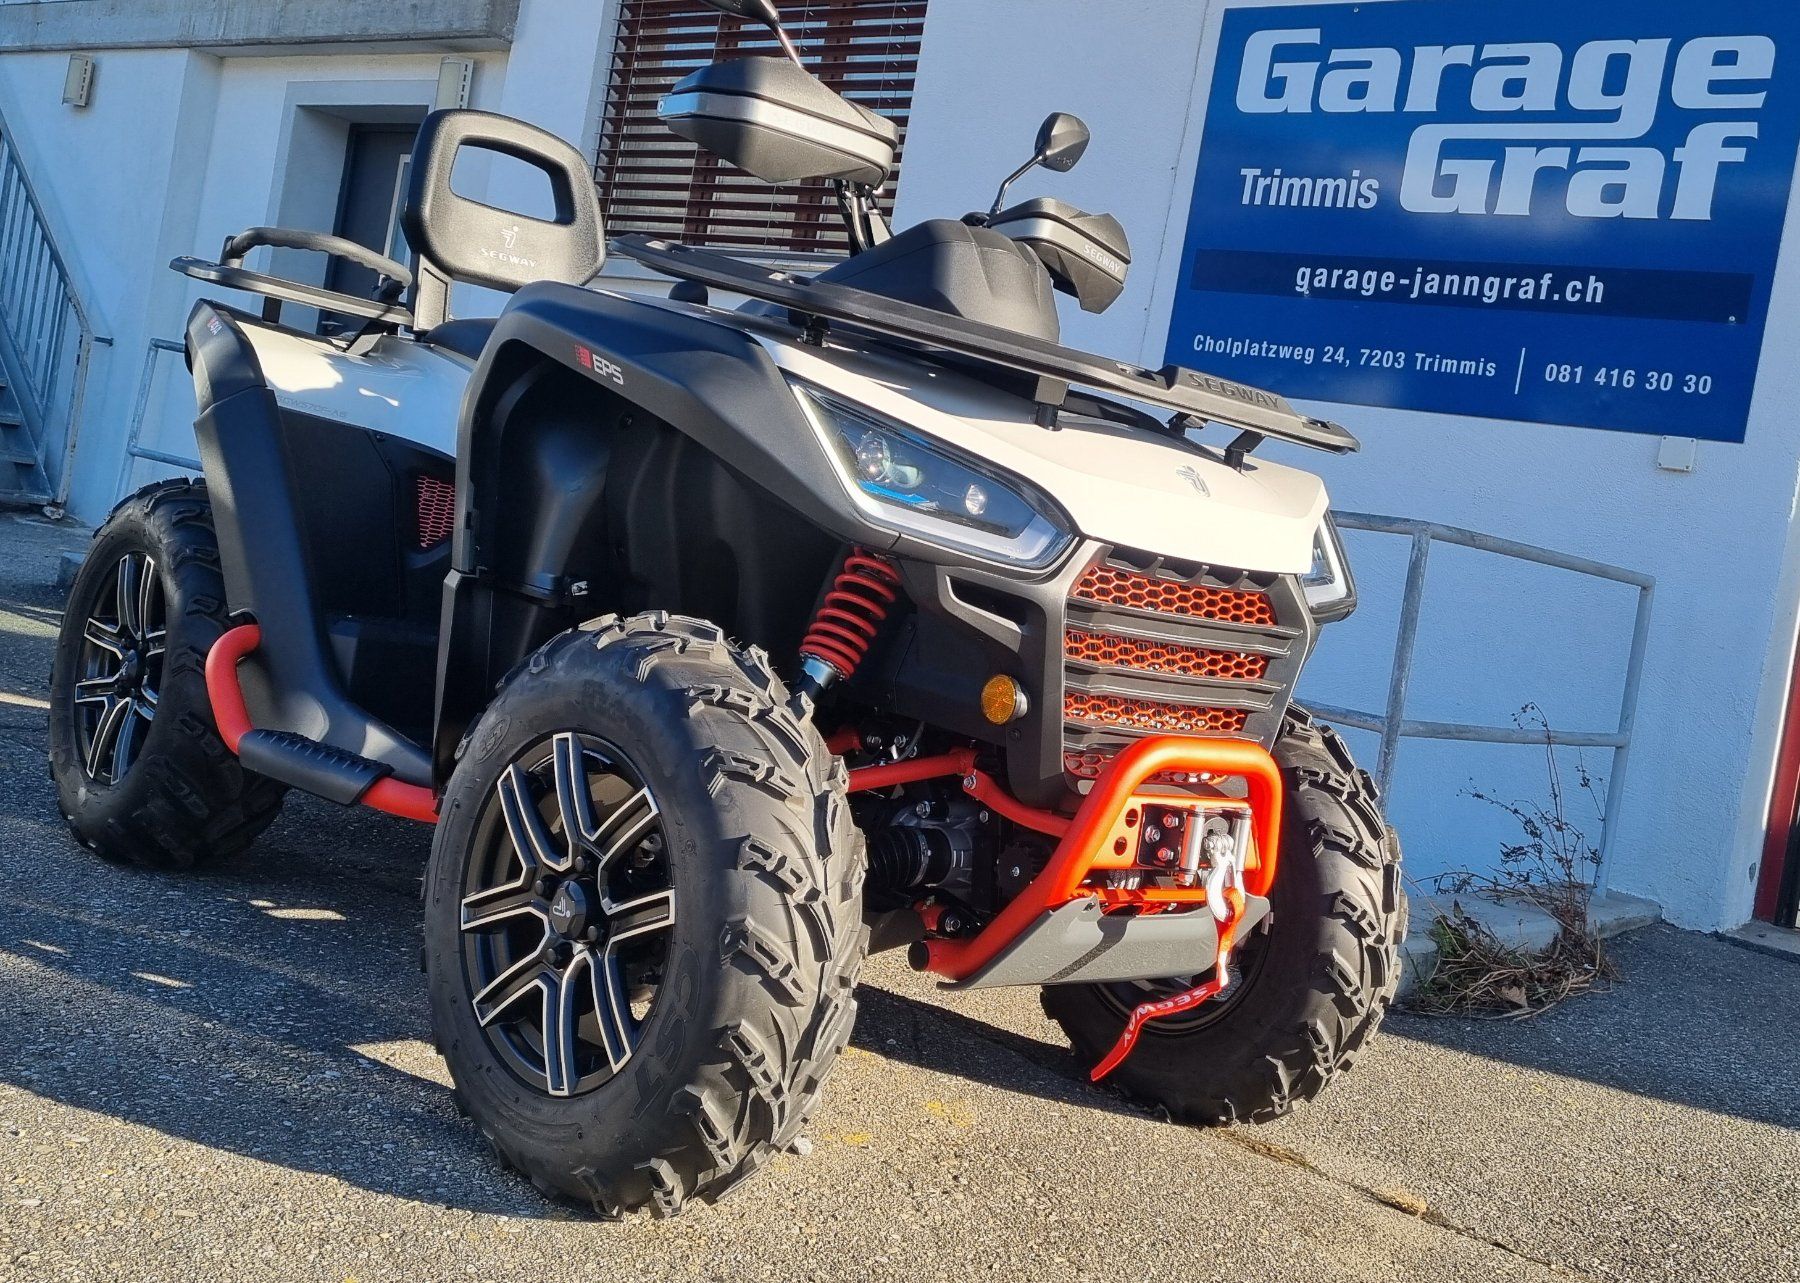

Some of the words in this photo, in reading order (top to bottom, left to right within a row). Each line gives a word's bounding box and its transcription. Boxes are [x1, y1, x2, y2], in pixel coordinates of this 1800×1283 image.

[1236, 29, 1775, 139] Garage
[1240, 168, 1380, 209] Trimmis
[1400, 122, 1758, 221] Graf
[480, 247, 537, 268] SEGWAY
[1083, 244, 1121, 273] SEGWAY
[1295, 266, 1604, 304] garage-janngraf.ch
[592, 353, 624, 385] EPS
[1193, 334, 1315, 365] Cholplatzweg
[1322, 346, 1350, 368] 24,
[1360, 349, 1406, 369] 7203
[1415, 352, 1497, 377] Trimmis
[1188, 372, 1280, 409] SEGWAY
[1545, 363, 1583, 384] 081
[1594, 367, 1636, 388] 416
[1645, 371, 1673, 391] 30
[1683, 374, 1712, 395] 30
[1123, 986, 1208, 1048] SEGWAY
